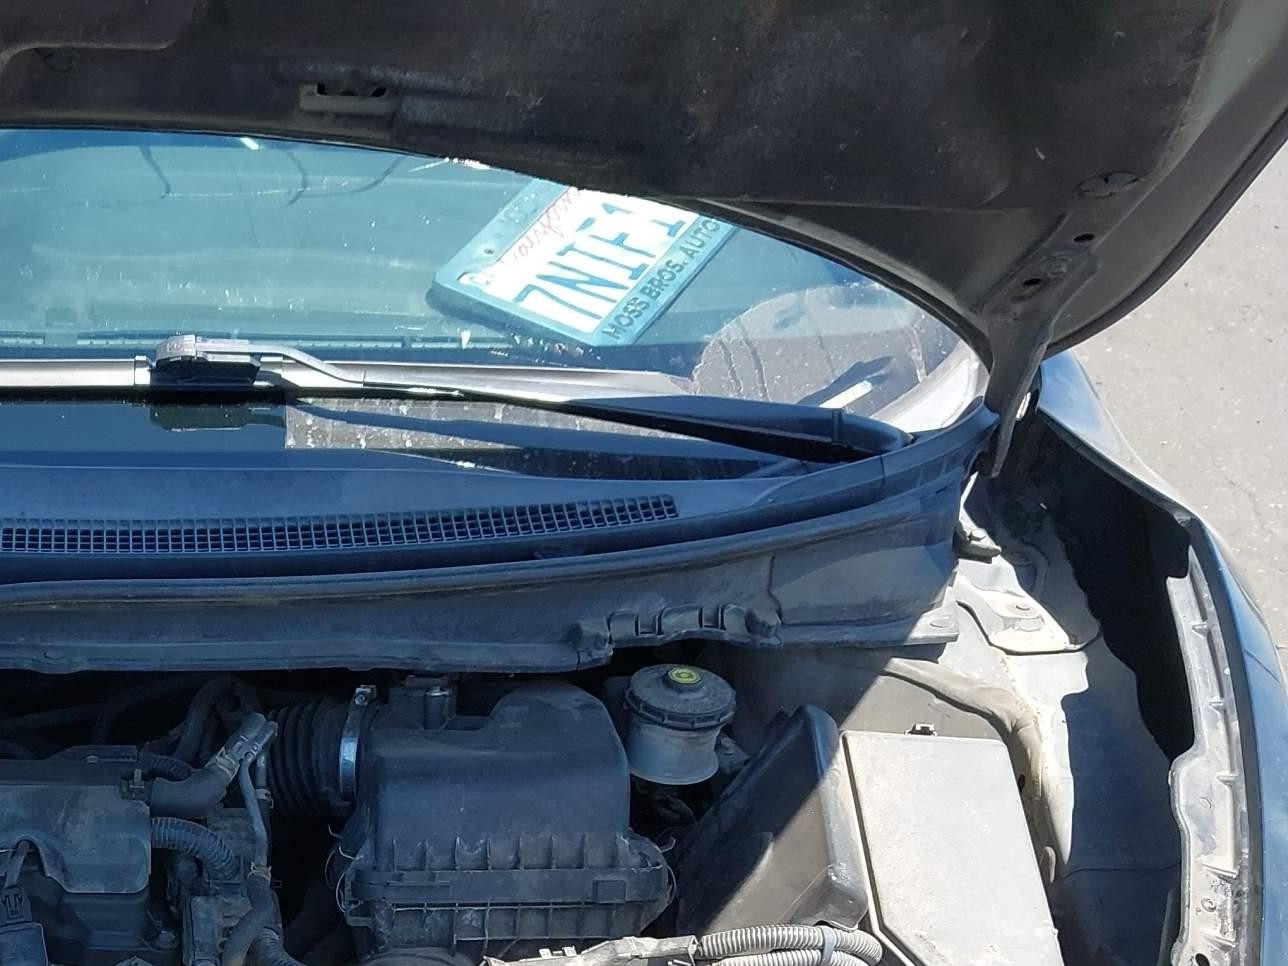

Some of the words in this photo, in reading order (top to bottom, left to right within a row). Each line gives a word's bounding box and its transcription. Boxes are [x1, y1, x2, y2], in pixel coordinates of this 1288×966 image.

[602, 297, 650, 340] MOSS
[640, 259, 689, 301] BROS.
[679, 219, 721, 261] AUTO
